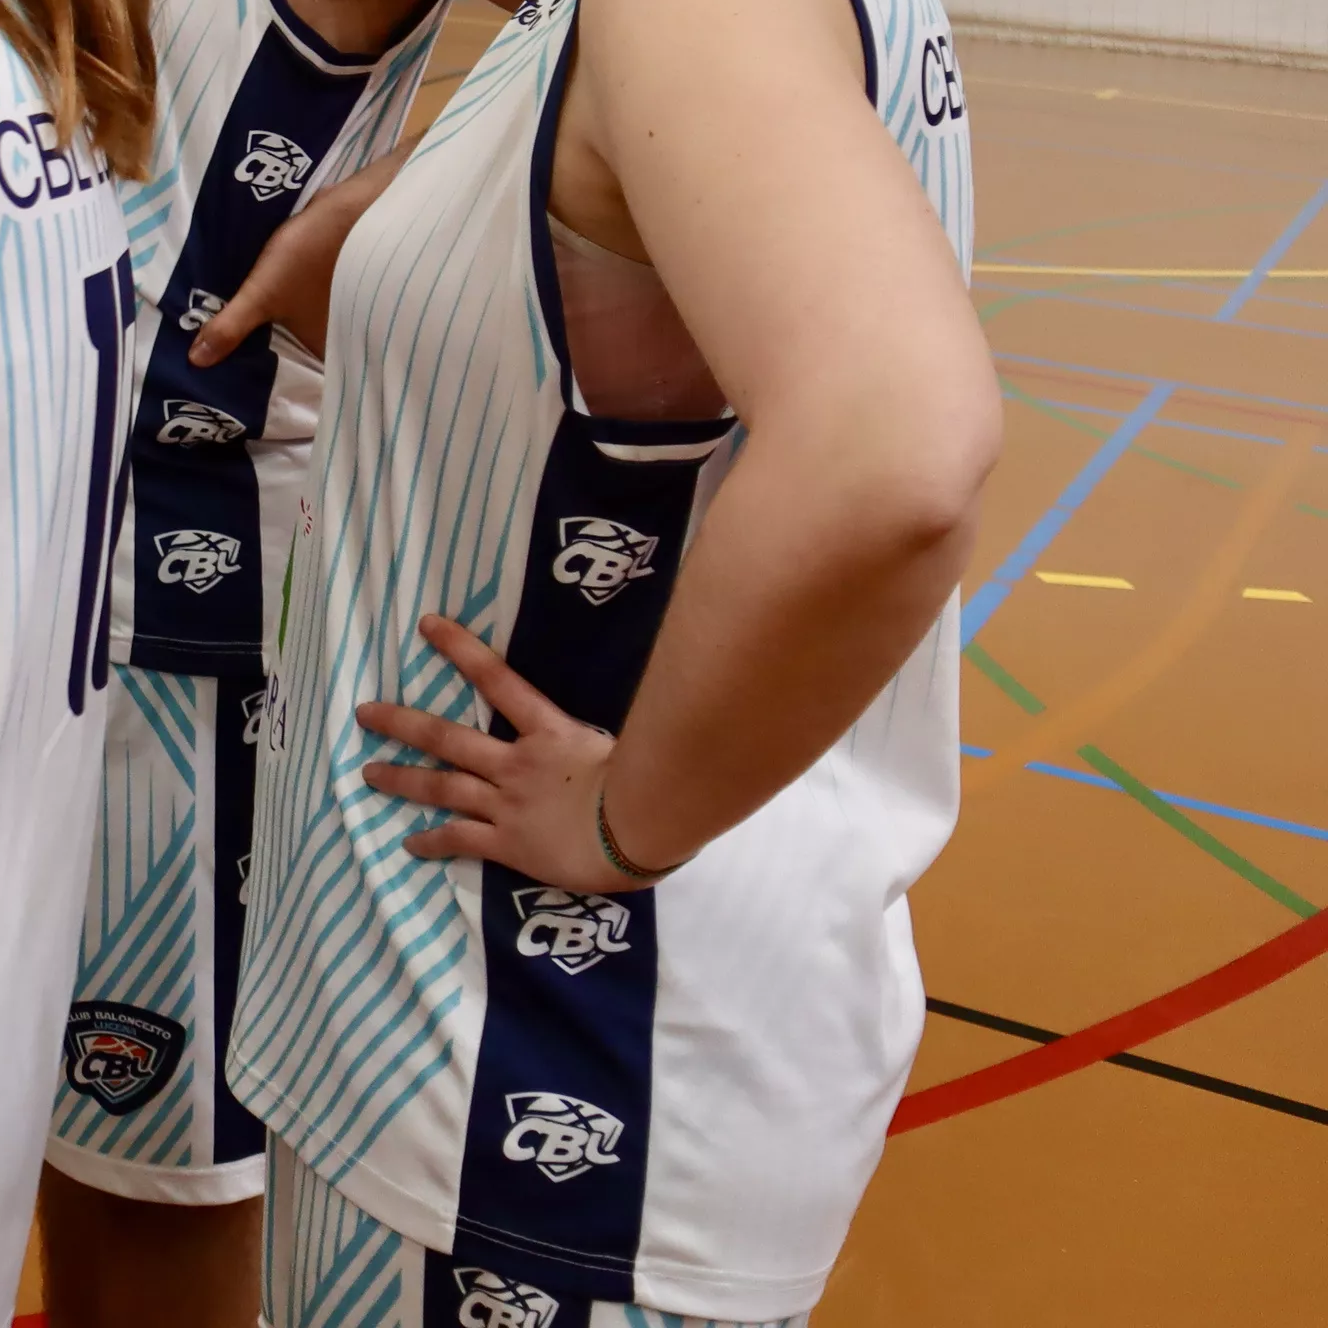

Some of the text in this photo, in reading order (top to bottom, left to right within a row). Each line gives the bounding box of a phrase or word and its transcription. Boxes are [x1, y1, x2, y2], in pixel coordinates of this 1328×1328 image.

[235, 149, 302, 190] CBL
[157, 549, 242, 584] CBL
[553, 540, 655, 588] CBL
[516, 913, 631, 957] CBL
[95, 1011, 172, 1041] BALONCESTO
[79, 1052, 155, 1082] CBL
[503, 1117, 620, 1165] CBL
